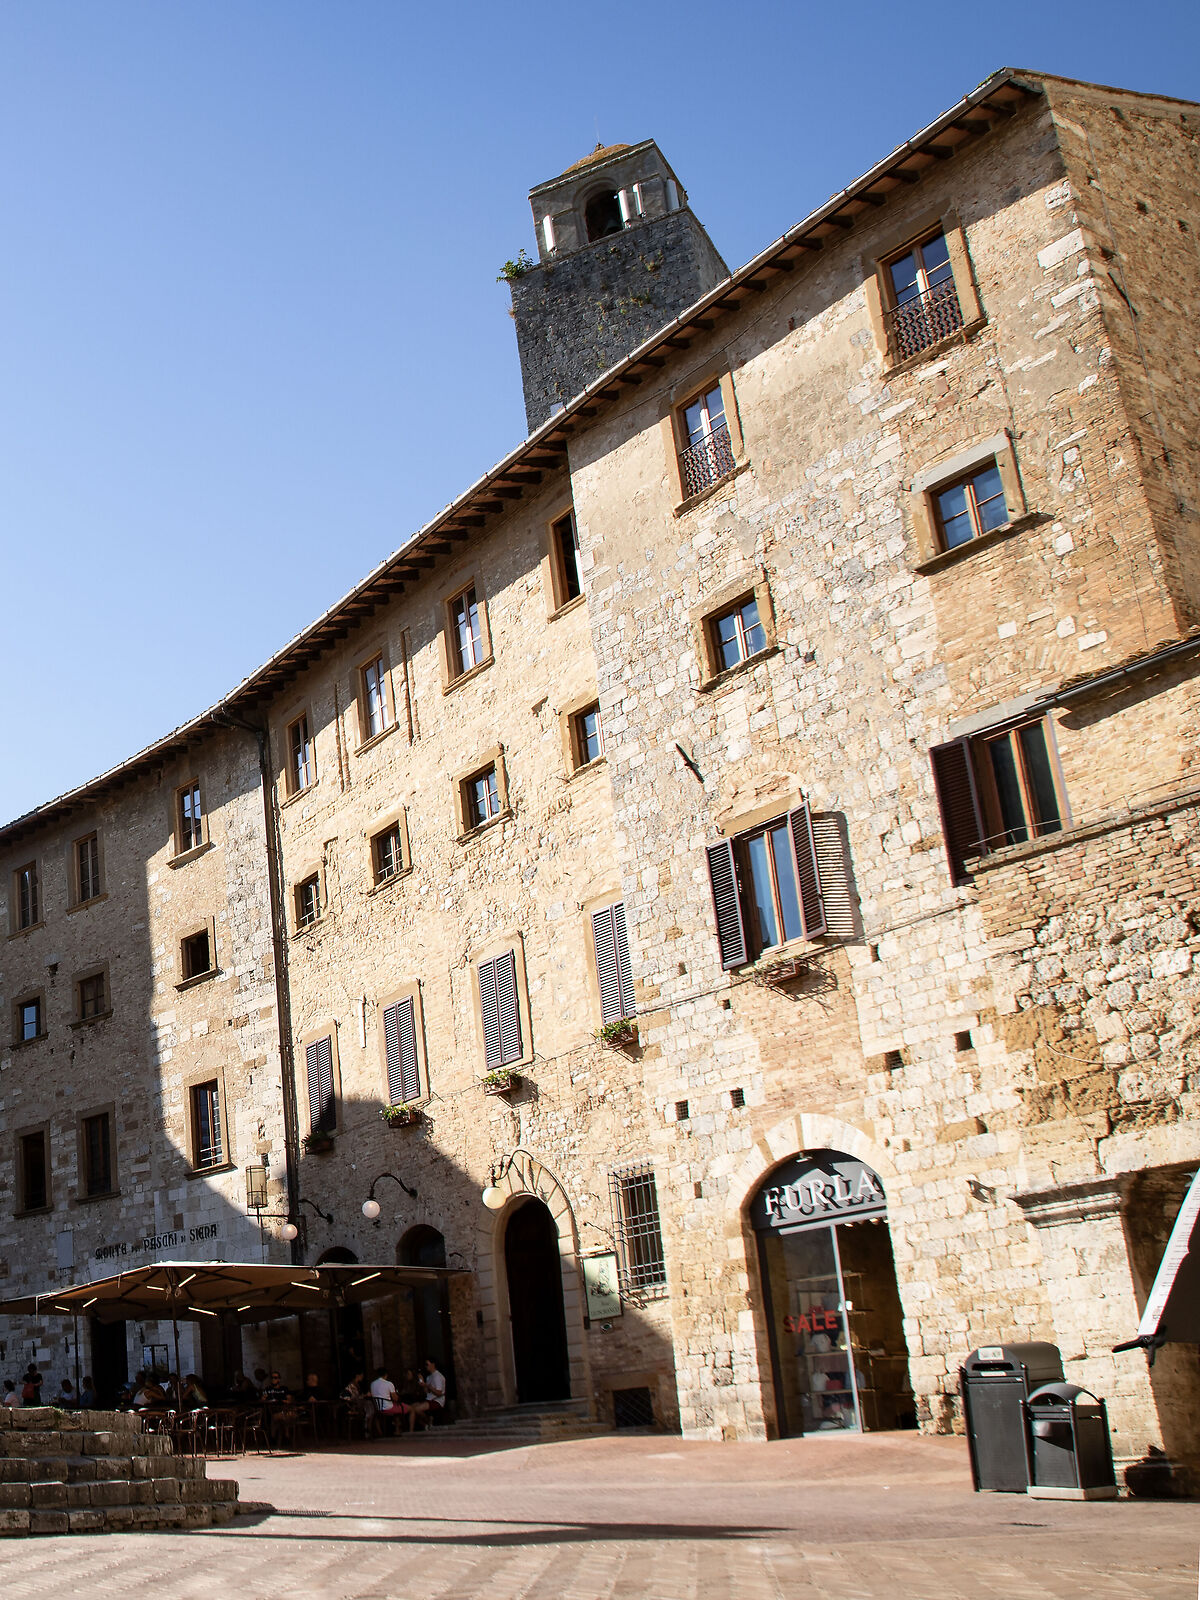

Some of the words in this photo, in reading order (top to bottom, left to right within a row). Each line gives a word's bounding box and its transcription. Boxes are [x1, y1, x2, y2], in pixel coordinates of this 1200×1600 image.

[763, 1169, 879, 1216] FURLA
[143, 1232, 177, 1251] PASCHI
[189, 1223, 218, 1242] SIENA
[783, 1309, 839, 1334] SALE
